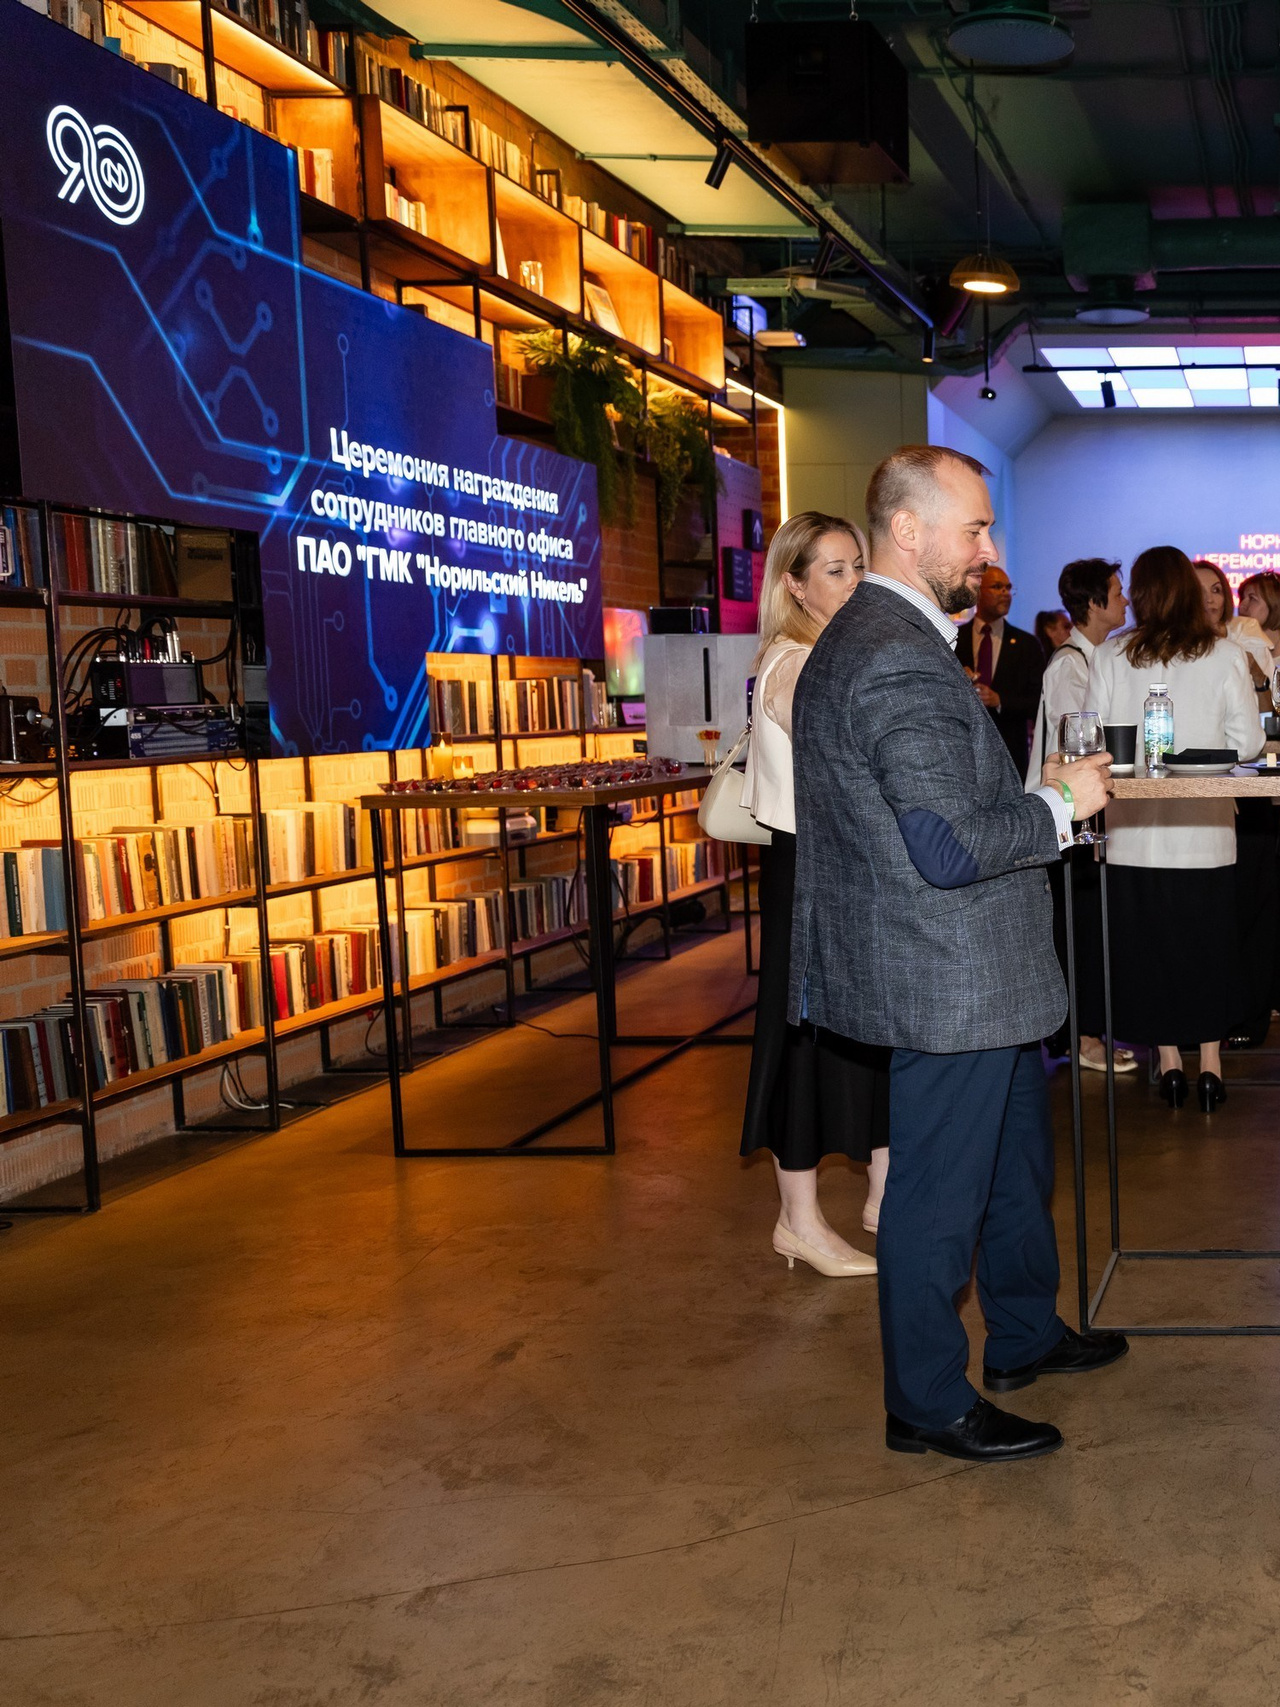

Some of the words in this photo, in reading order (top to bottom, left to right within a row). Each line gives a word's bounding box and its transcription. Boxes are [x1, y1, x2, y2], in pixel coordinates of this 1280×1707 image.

[329, 427, 450, 489] Церемония
[453, 467, 559, 514] награждения
[310, 489, 446, 537] сотрудников
[449, 516, 525, 551] главного
[527, 528, 574, 563] офиса
[296, 535, 352, 577] ПАО
[356, 544, 414, 585] "ГМК
[416, 553, 529, 597] "Норильский
[530, 570, 588, 604] Никель"
